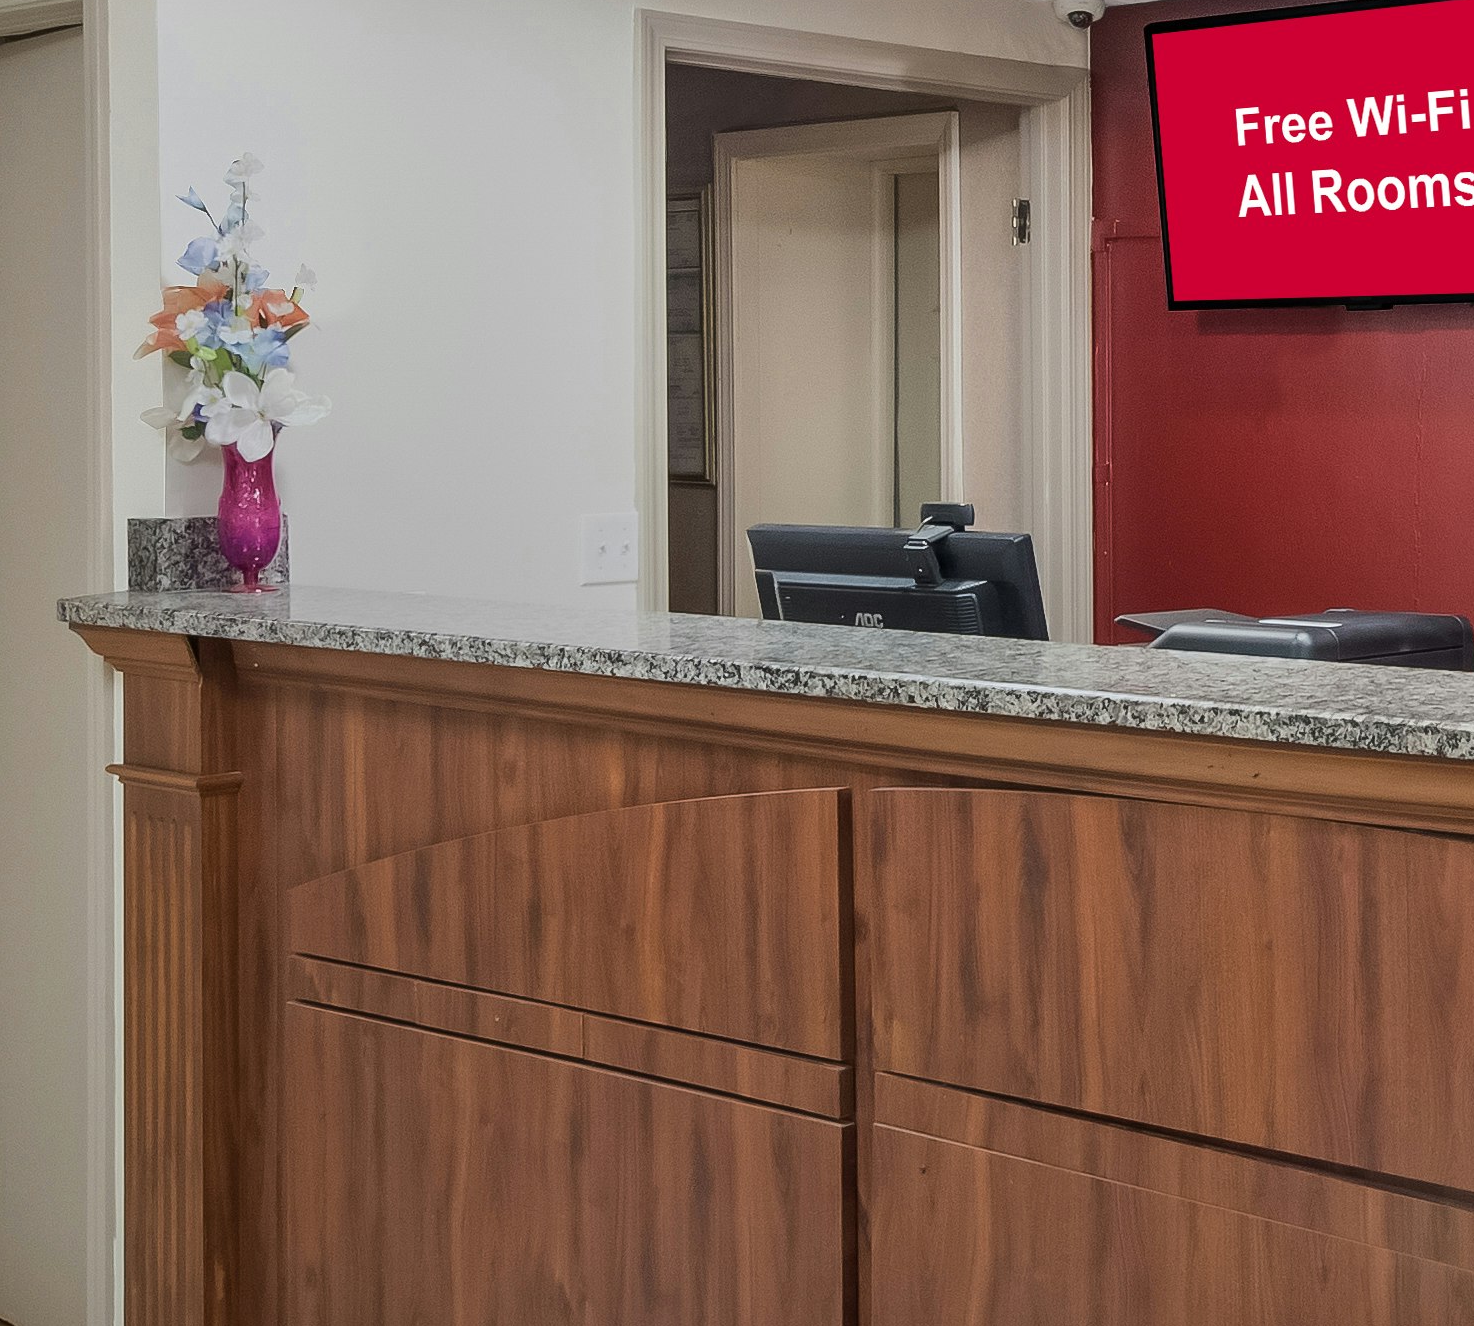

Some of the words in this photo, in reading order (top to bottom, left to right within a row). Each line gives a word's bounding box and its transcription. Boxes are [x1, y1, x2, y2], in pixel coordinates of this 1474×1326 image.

[1236, 107, 1333, 146] Free
[1346, 89, 1470, 137] Wi-Fi
[1239, 172, 1295, 217] All
[855, 612, 884, 629] AOC
